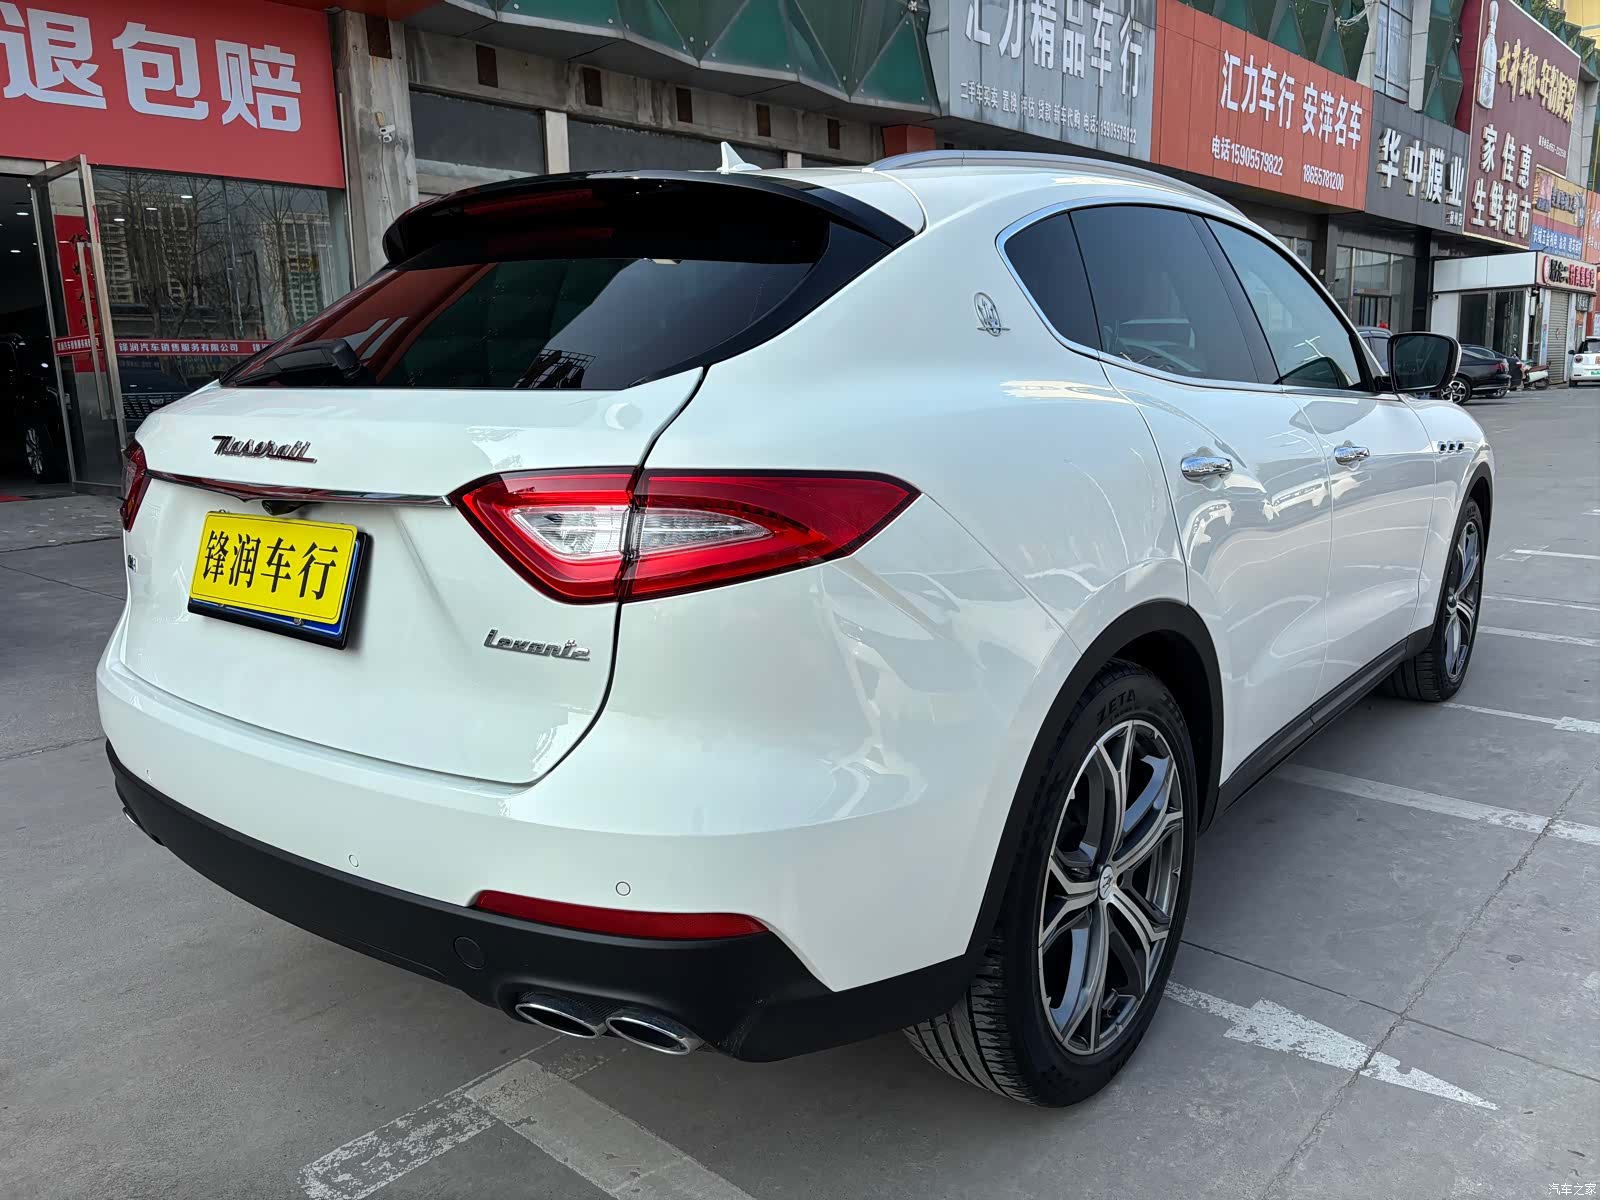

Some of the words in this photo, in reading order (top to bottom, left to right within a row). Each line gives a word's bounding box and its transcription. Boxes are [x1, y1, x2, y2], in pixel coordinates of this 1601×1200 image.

[0, 1, 302, 132] 退包赔
[960, 81, 998, 109] 二手车买卖
[1002, 90, 1018, 113] 置换
[1220, 49, 1295, 130] 汇力车行
[1302, 82, 1363, 150] 安萍名车
[1303, 164, 1344, 191] 18655781200
[1376, 127, 1465, 207] 华中膜业
[1480, 123, 1534, 189] 家佳惠
[1471, 178, 1532, 238] 生鲜超市
[119, 342, 239, 353] 锋润汽车销售服务有限公司
[202, 529, 339, 600] 锋润车行
[483, 628, 591, 662] Levante
[1096, 689, 1136, 722] ZETA
